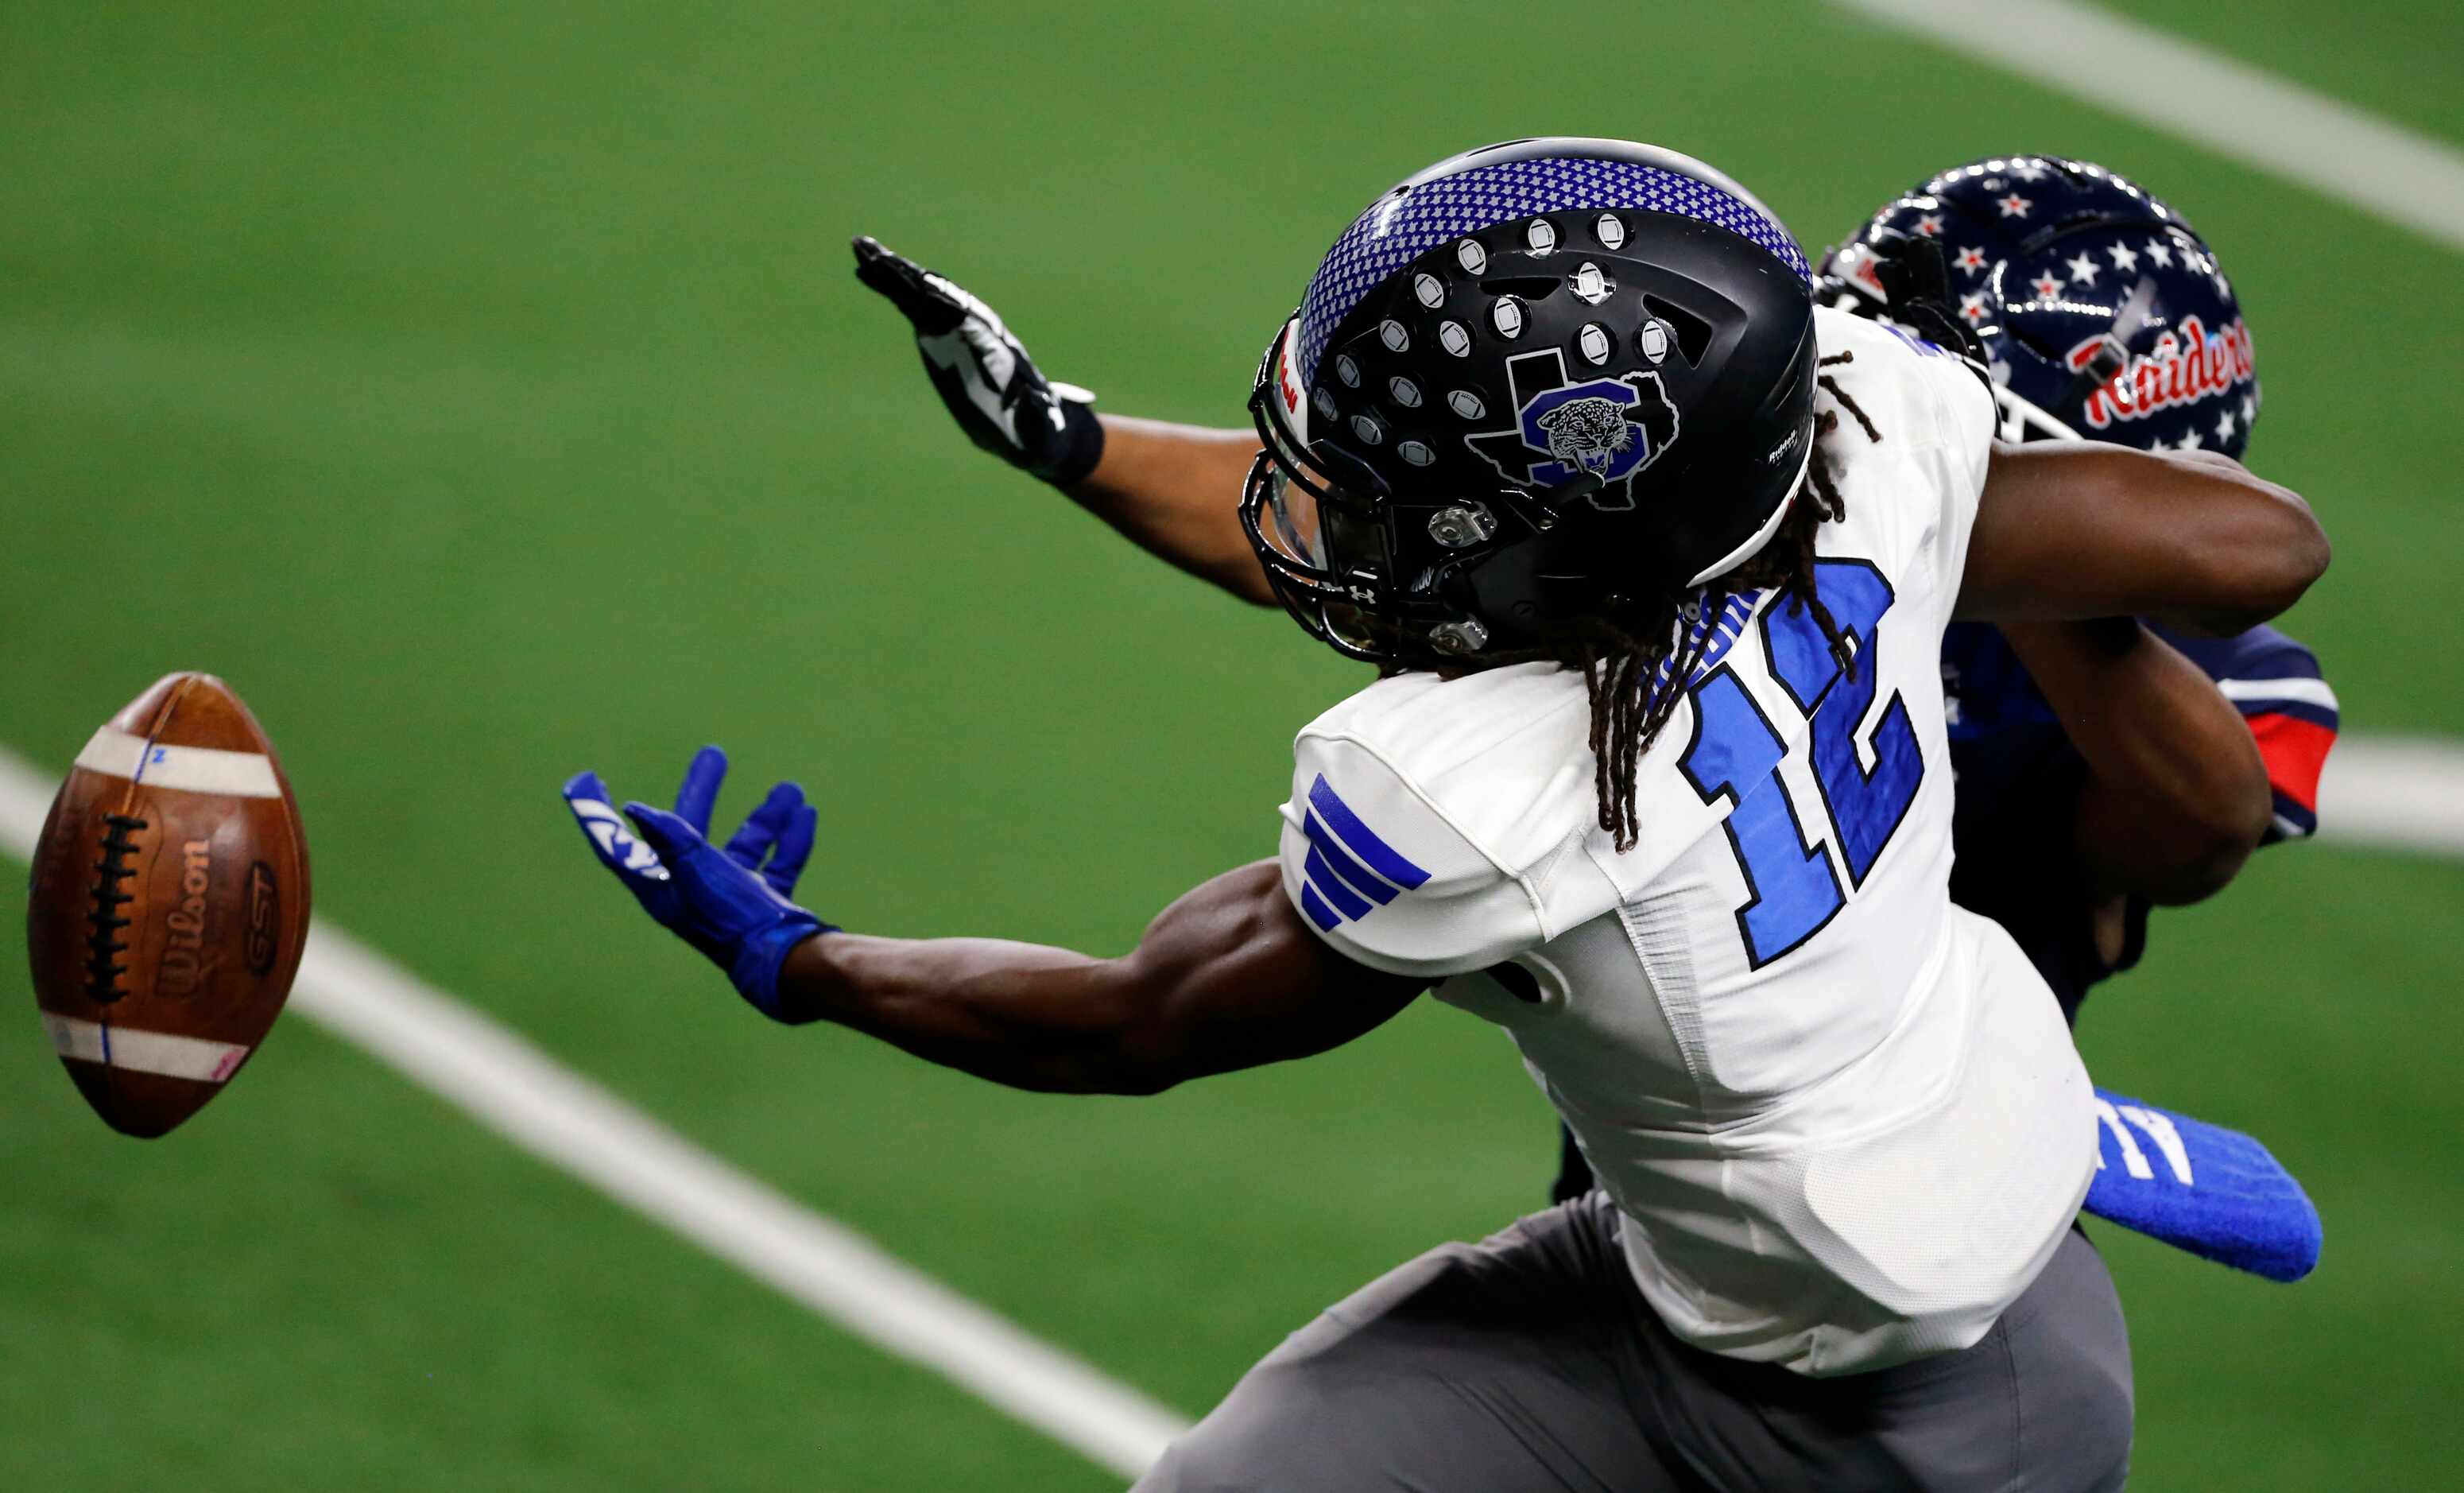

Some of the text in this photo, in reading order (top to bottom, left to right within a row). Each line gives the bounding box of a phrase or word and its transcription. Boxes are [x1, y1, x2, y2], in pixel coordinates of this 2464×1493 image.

[1676, 556, 1925, 972] 12
[155, 839, 211, 996] Wilson
[249, 865, 273, 967] GST
